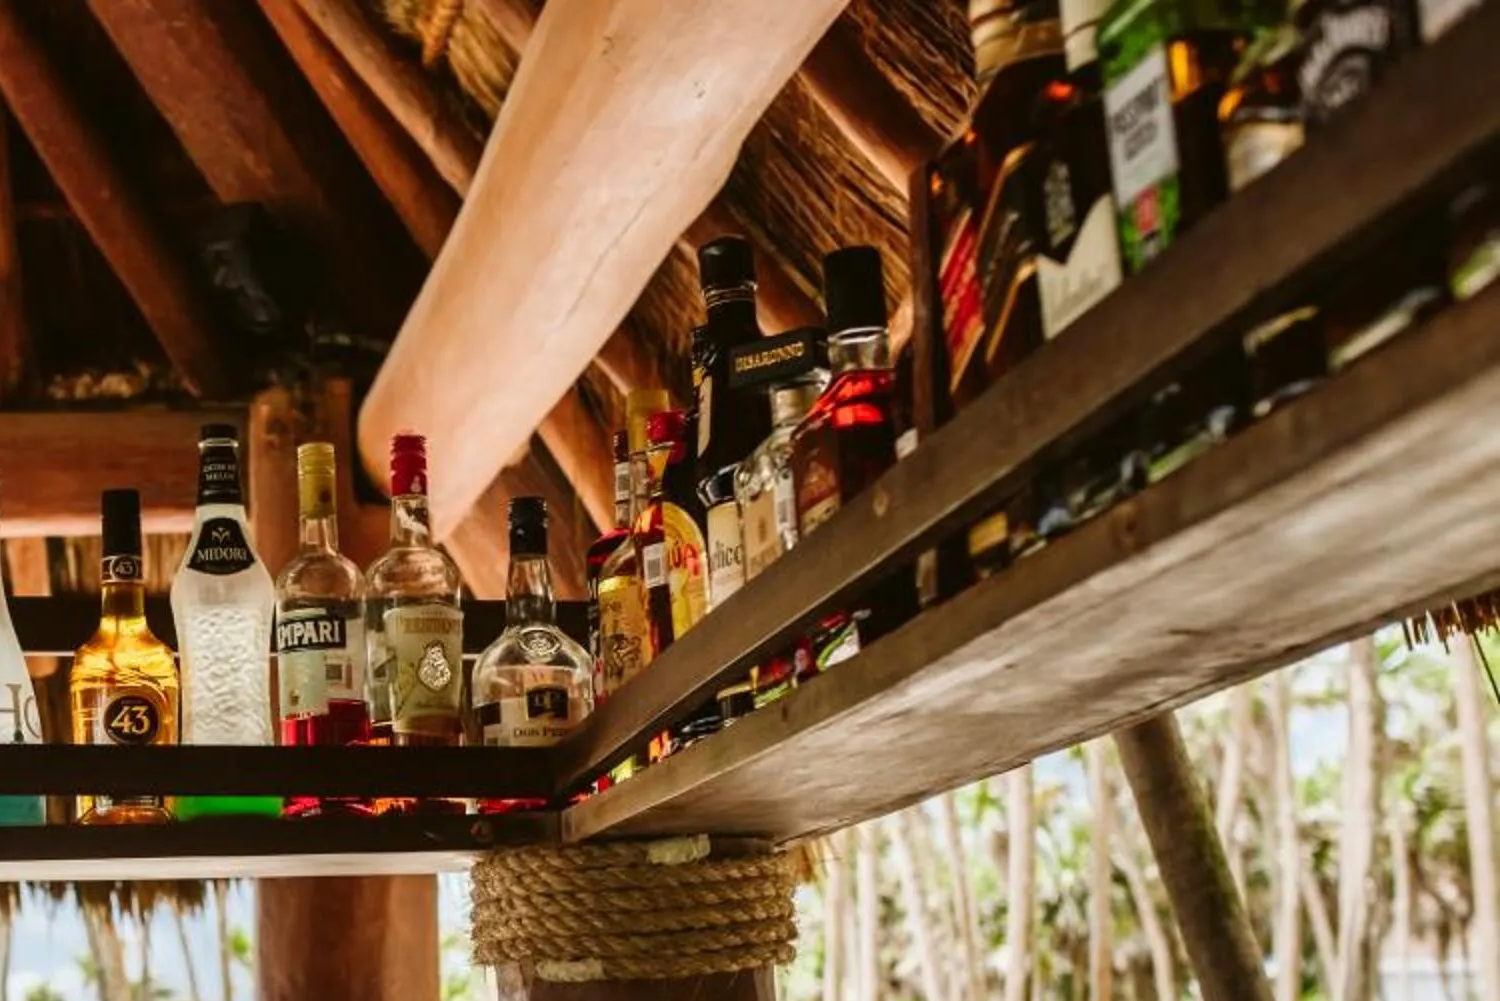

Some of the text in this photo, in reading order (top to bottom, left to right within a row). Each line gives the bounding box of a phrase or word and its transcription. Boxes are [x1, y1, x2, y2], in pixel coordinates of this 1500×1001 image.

[197, 547, 248, 561] MIDORI
[277, 621, 341, 651] MPARI
[111, 705, 151, 735] 43
